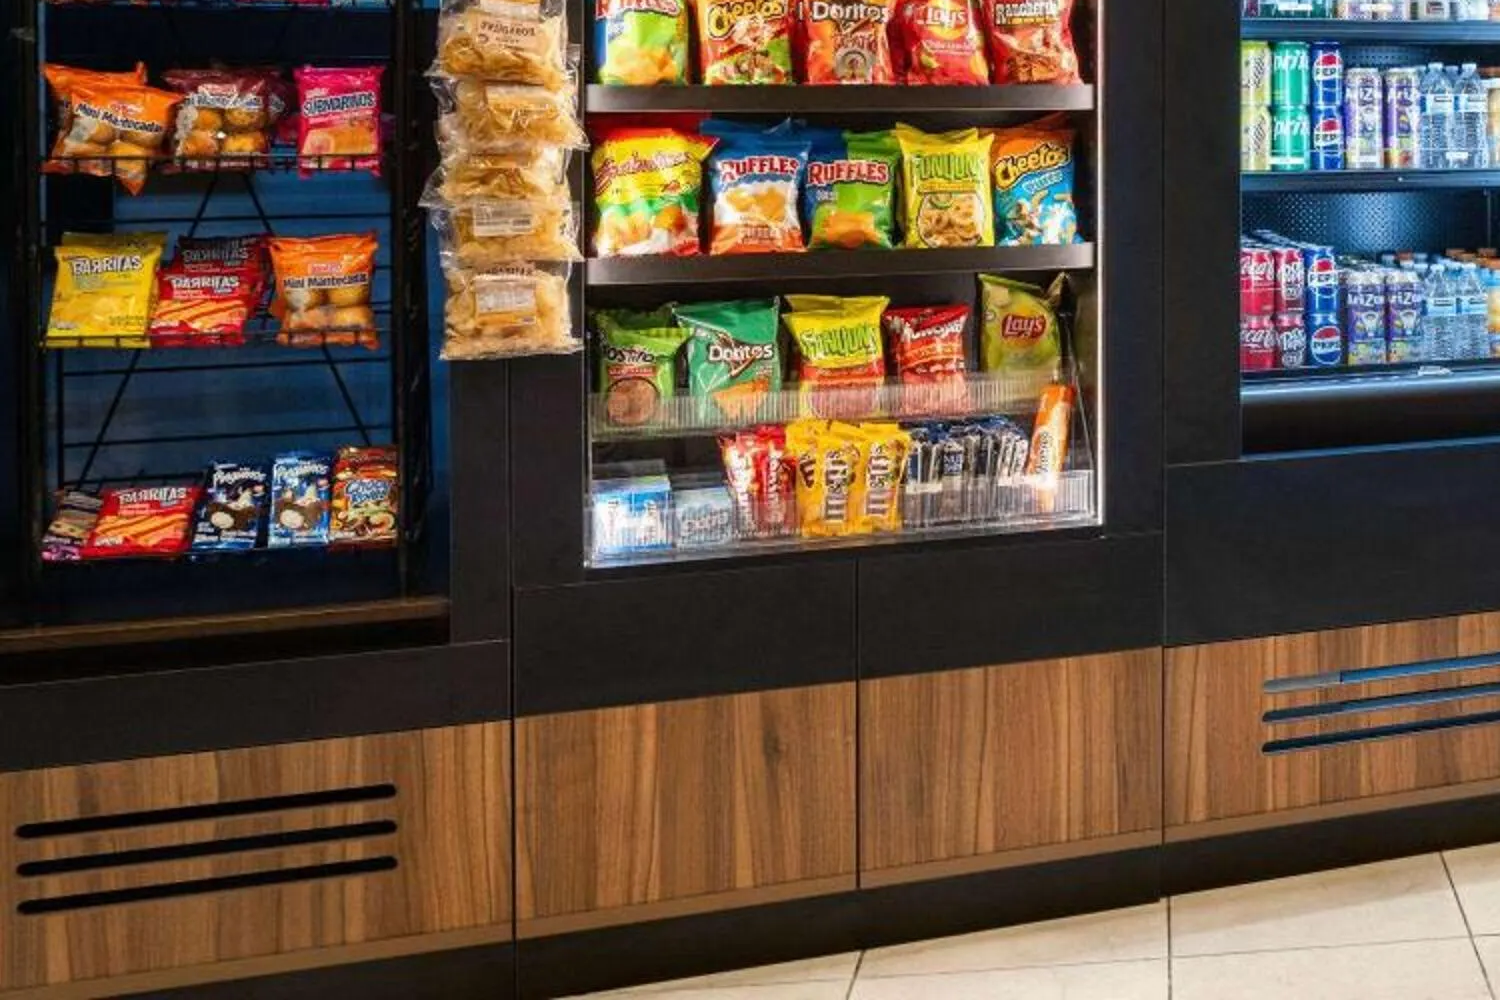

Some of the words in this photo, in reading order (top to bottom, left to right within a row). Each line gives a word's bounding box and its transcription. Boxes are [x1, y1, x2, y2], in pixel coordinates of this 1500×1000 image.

[812, 0, 890, 24] Doritos
[718, 155, 800, 184] RUFFLES
[808, 160, 889, 186] RUFFLES
[1004, 314, 1044, 339] Lay's
[708, 344, 773, 362] Doritos
